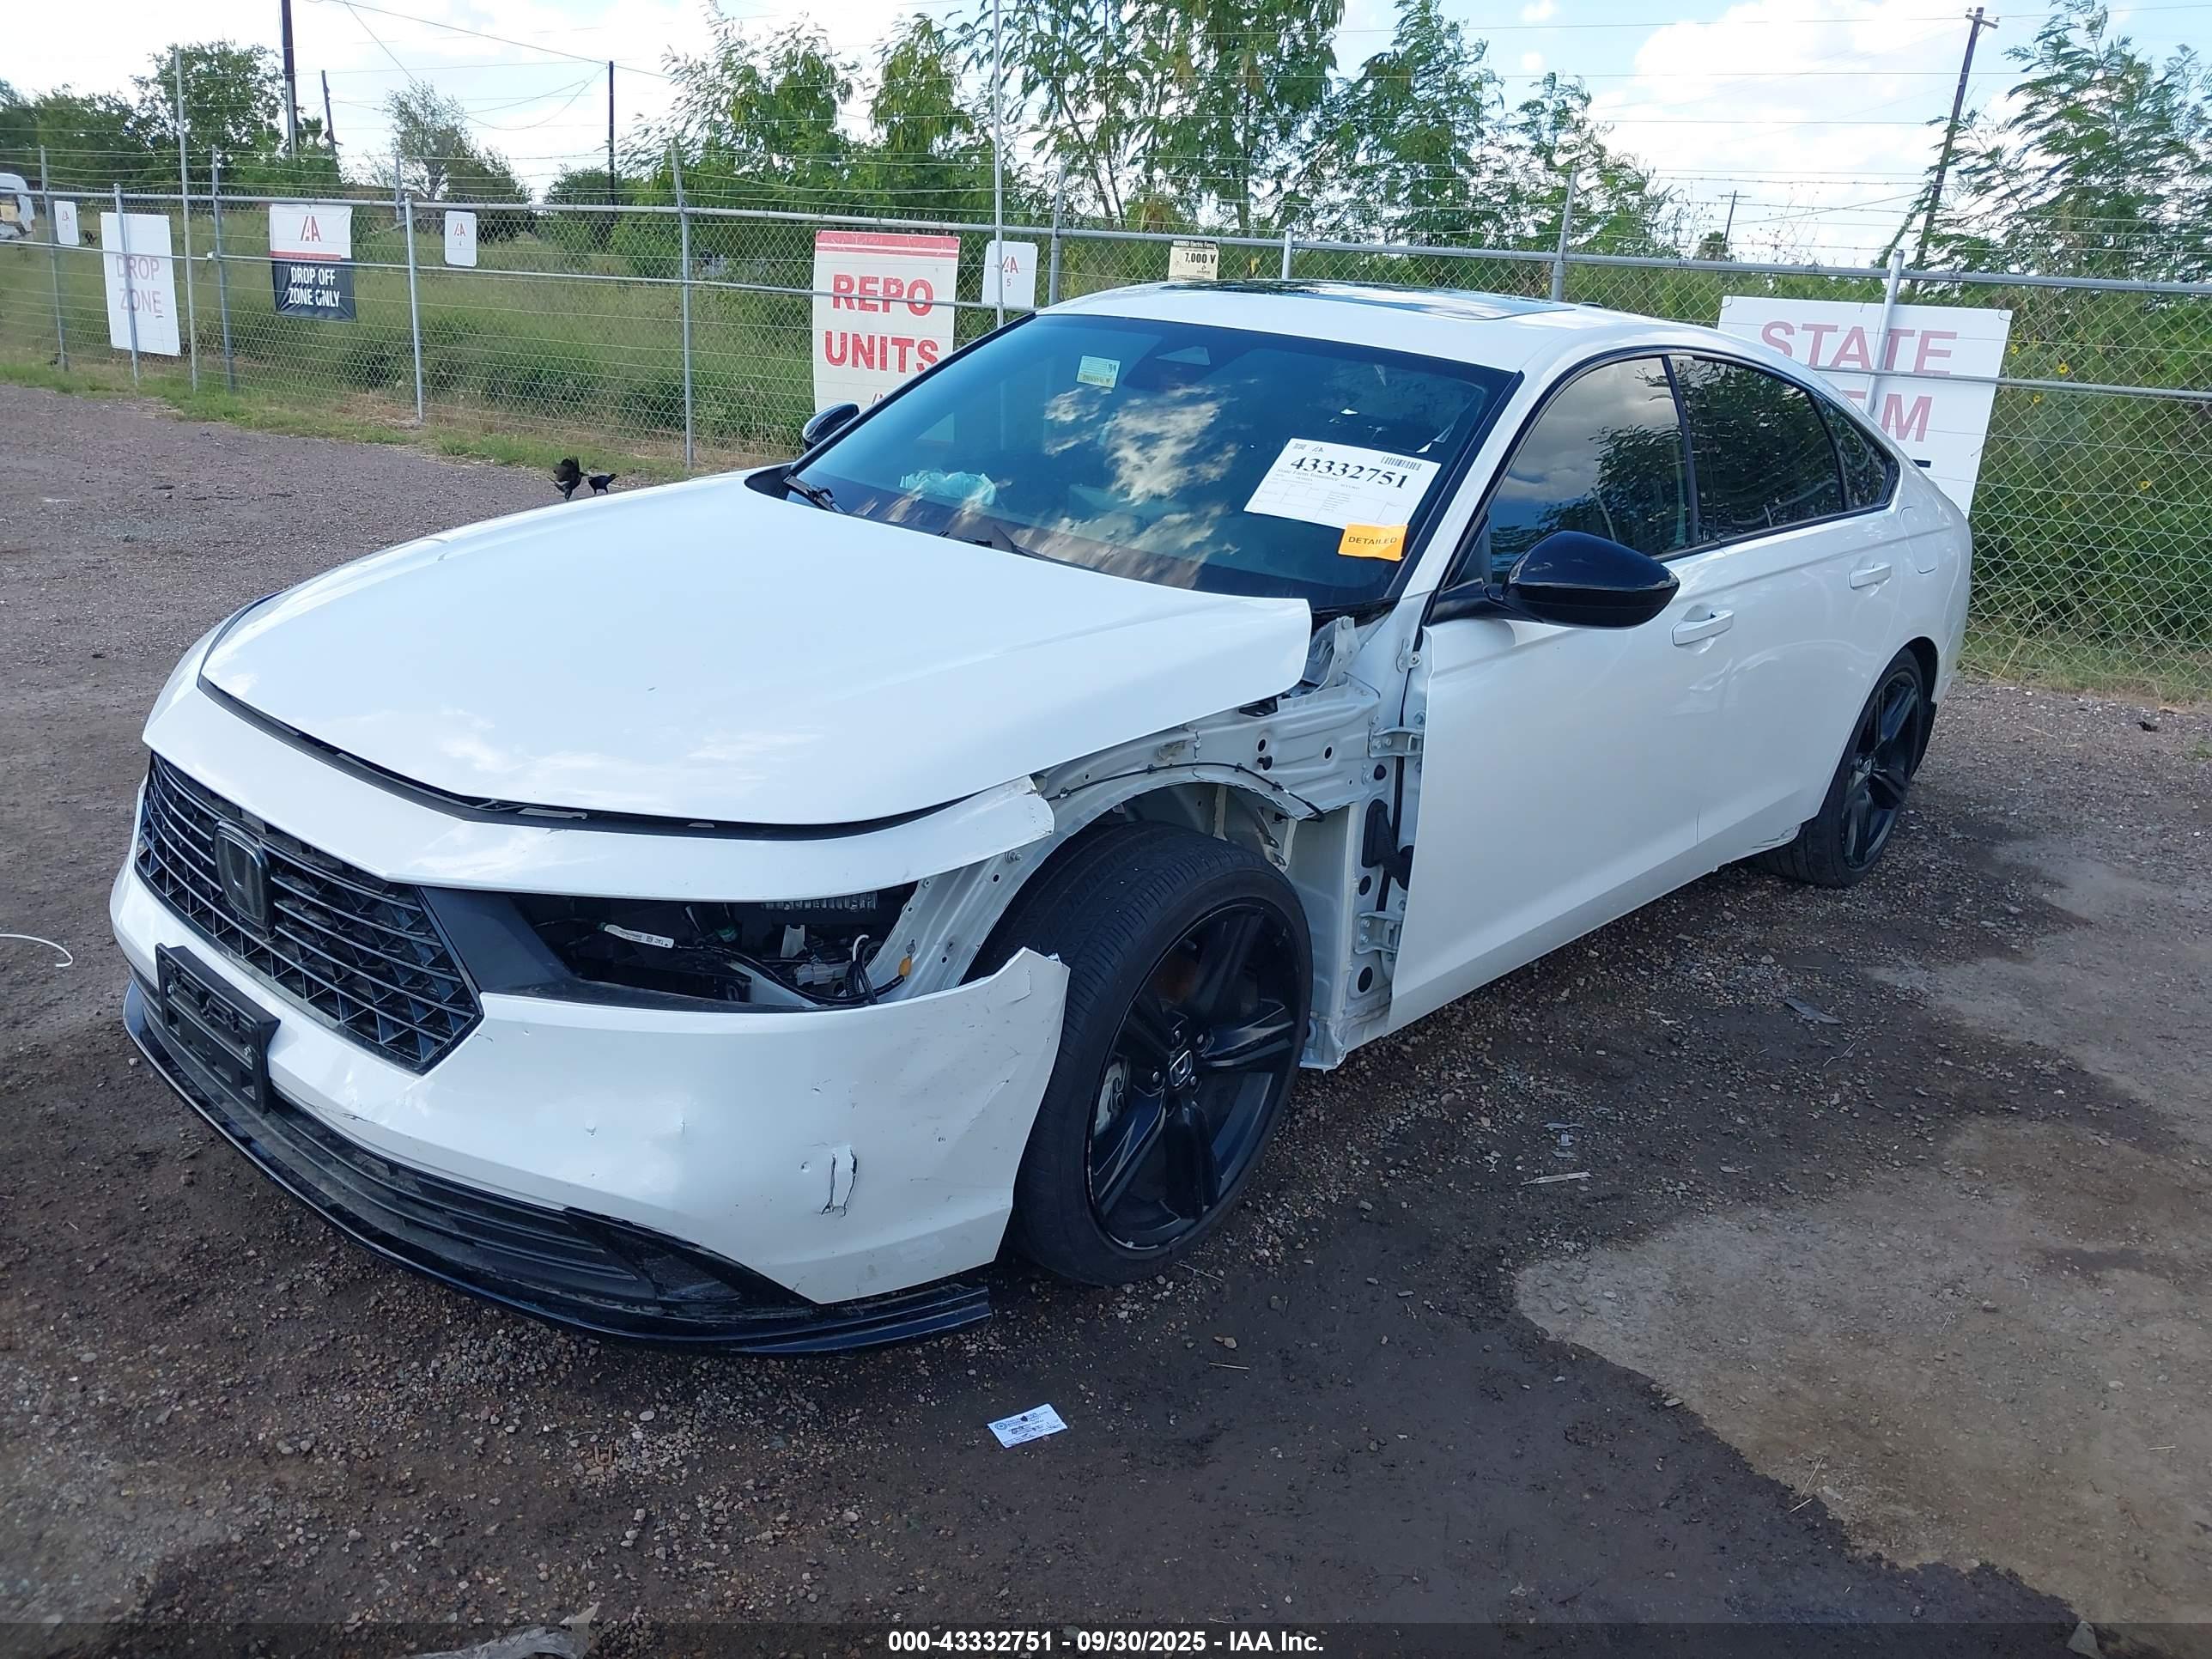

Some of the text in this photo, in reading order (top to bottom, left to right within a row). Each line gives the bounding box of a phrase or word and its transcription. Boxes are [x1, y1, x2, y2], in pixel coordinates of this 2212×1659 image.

[116, 255, 160, 281] DROP
[1185, 252, 1217, 264] 7,000 V
[290, 267, 336, 286] DROP OFF
[1006, 278, 1012, 288] 5
[118, 288, 163, 313] ZONE
[288, 288, 340, 307] ZONE ONLY
[832, 274, 934, 317] REPO
[825, 330, 939, 374] UNITS
[1760, 320, 1958, 376] STATE
[1290, 456, 1408, 489] 43332751
[1348, 536, 1397, 545] DETAILED
